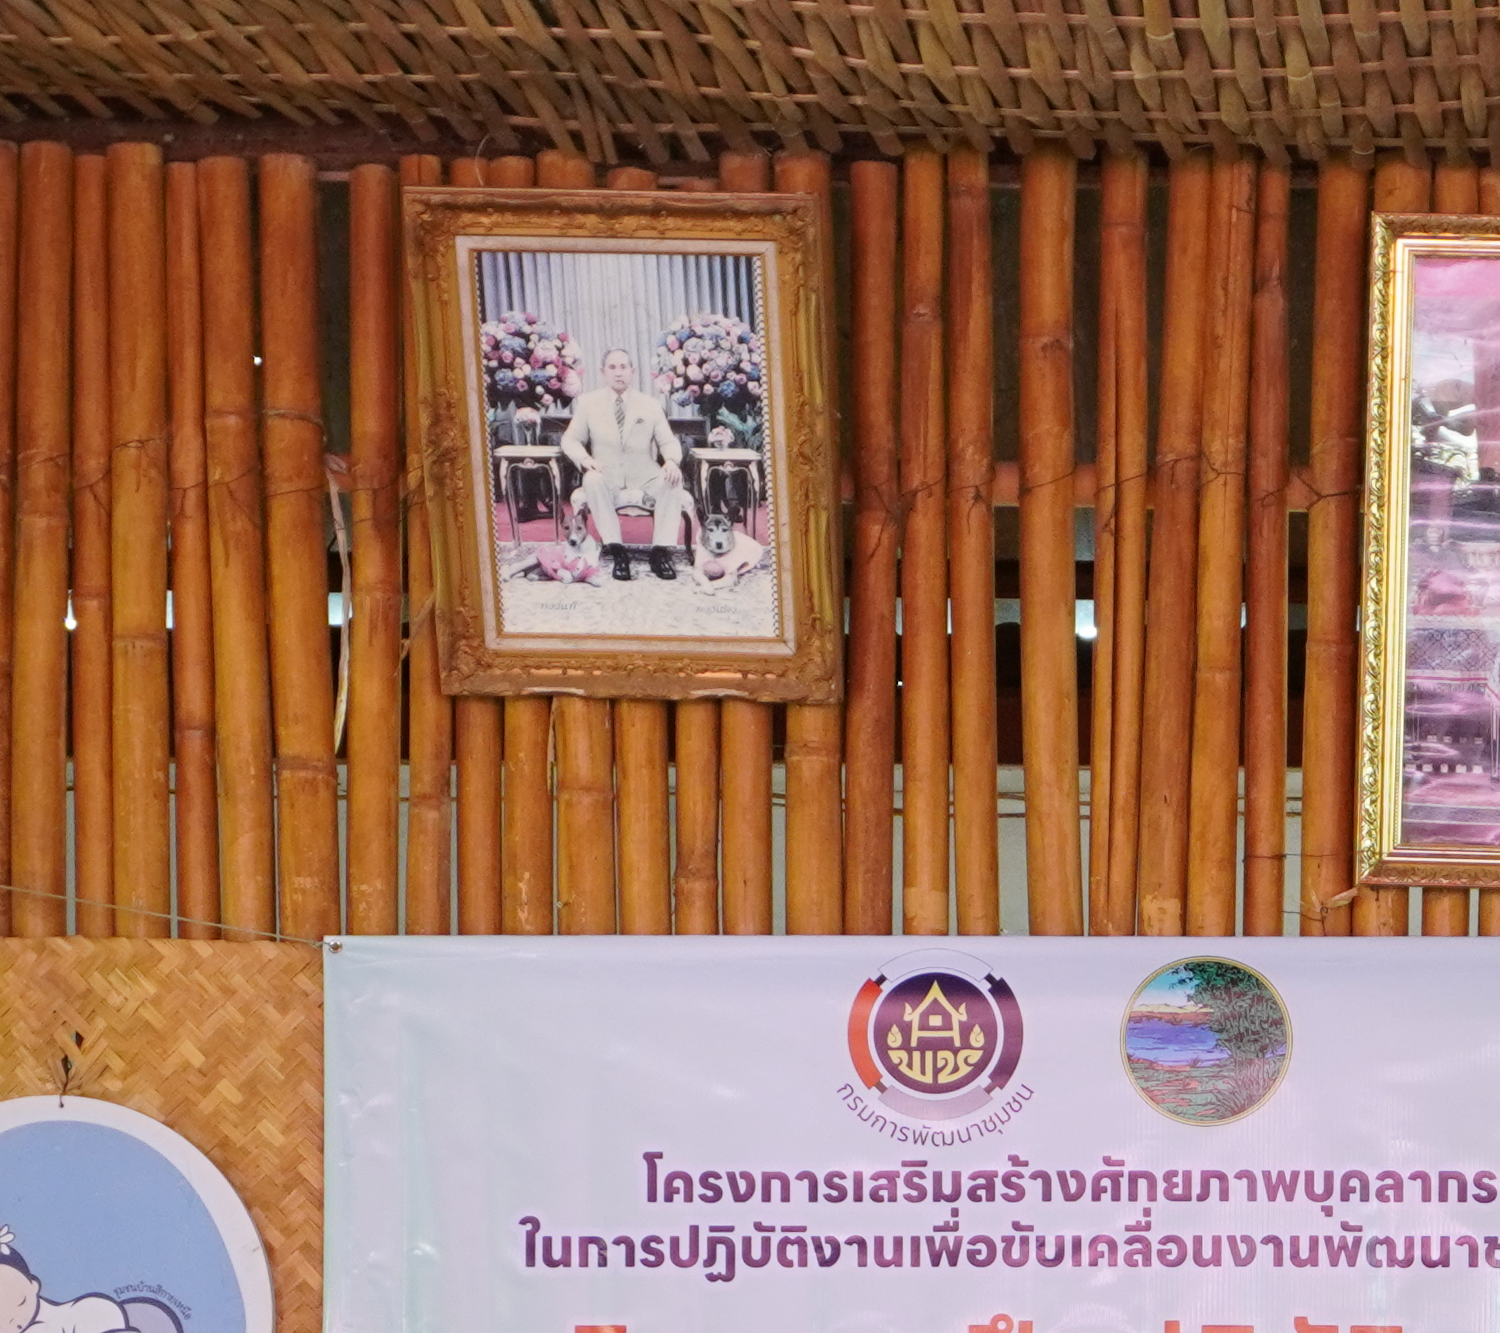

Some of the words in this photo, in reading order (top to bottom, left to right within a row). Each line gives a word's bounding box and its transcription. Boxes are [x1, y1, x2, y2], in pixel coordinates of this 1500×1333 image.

[836, 1083, 1035, 1147] กรมการพัฒนาชุมชน
[643, 1152, 1498, 1217] โครงการเสริมสร้างศักยภาพบุคลากร
